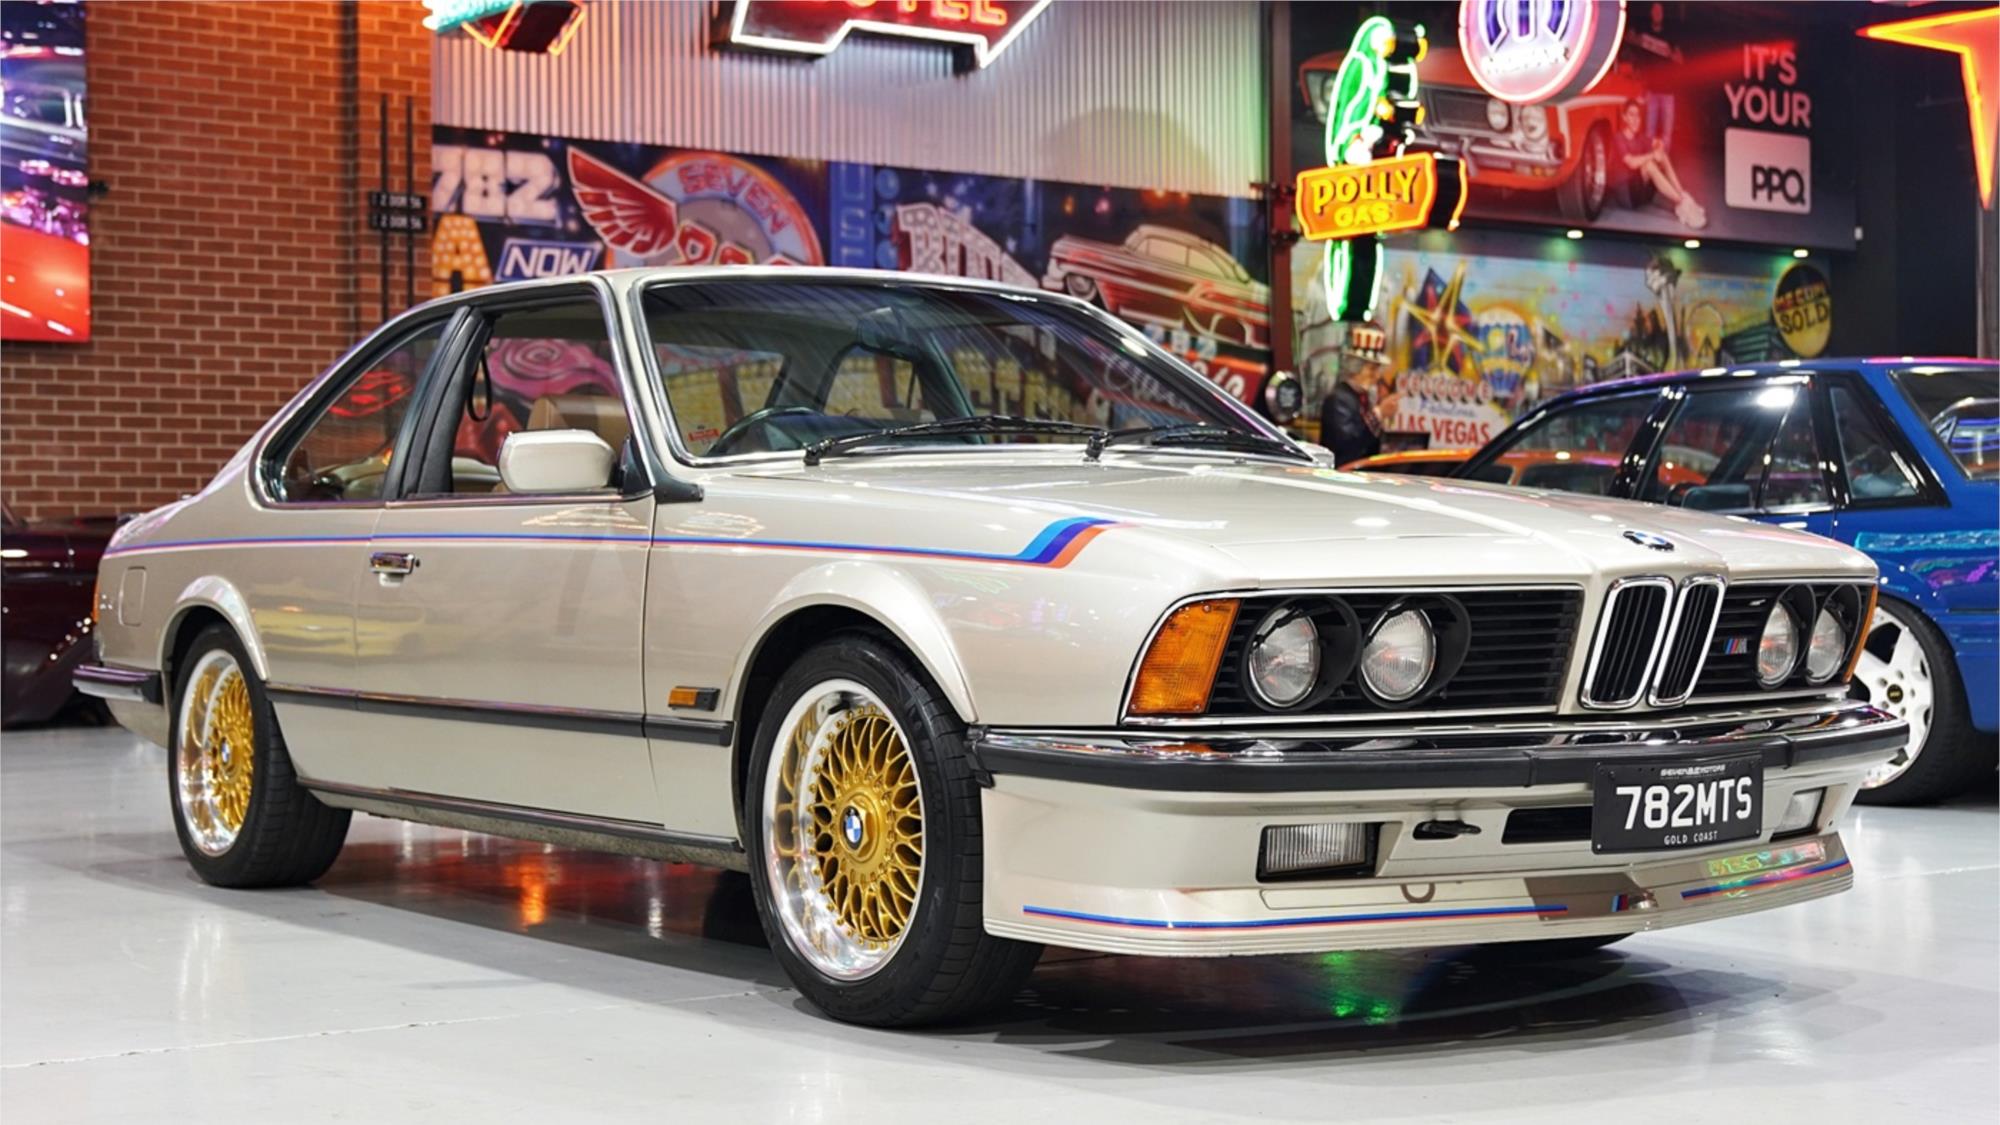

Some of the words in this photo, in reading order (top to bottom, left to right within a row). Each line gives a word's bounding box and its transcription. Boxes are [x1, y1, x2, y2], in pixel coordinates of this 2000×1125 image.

[1743, 44, 1797, 85] IT'S
[1724, 83, 1811, 128] YOUR
[677, 160, 791, 235] SEVEN
[1310, 167, 1416, 216] POLLY
[1752, 165, 1805, 206] PPQ
[1334, 201, 1391, 227] GAS
[503, 246, 592, 278] NOW
[1780, 303, 1829, 334] SOLD
[1431, 418, 1491, 446] VEGAS
[1616, 776, 1753, 830] 782MTS
[1664, 835, 1688, 845] GOLD
[1693, 831, 1718, 843] COAST
